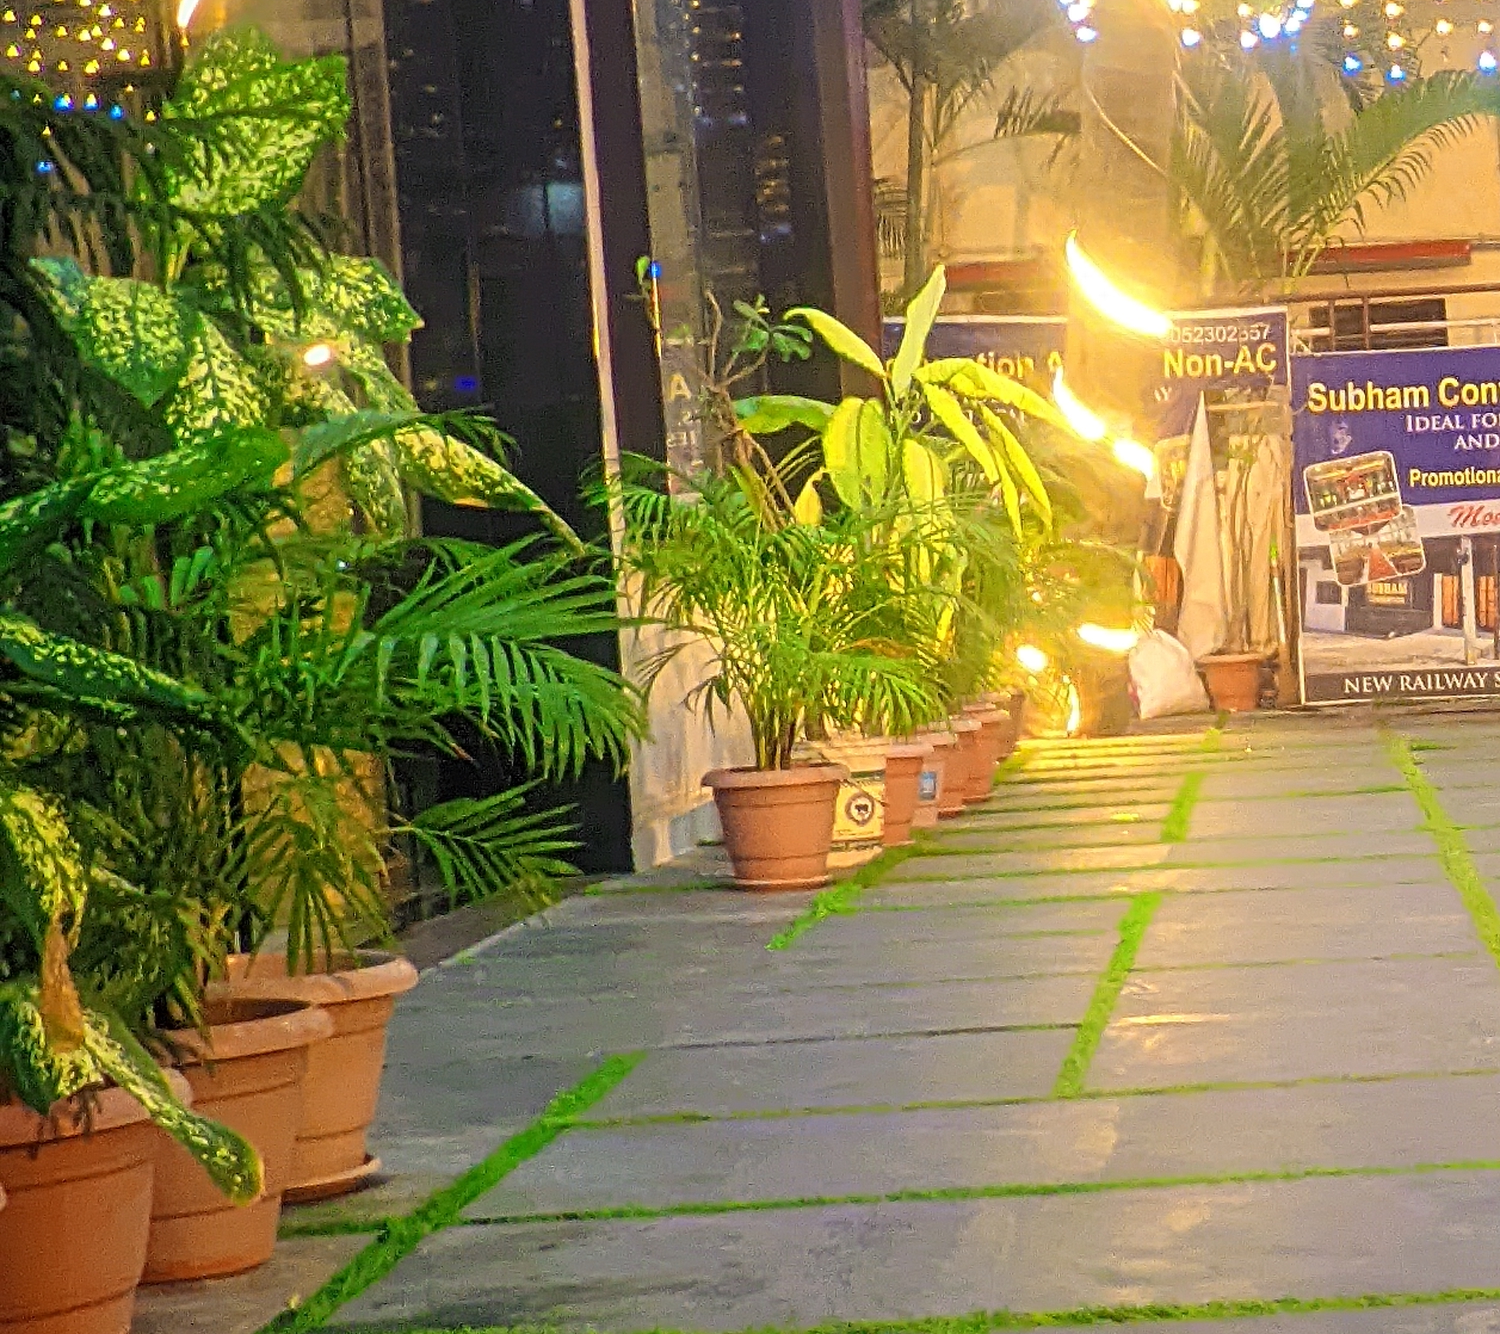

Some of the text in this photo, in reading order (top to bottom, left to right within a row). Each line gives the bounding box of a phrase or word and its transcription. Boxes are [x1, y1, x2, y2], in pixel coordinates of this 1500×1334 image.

[1163, 343, 1278, 378] Non-AC
[1307, 379, 1430, 413] Subham
[1406, 415, 1465, 432] IDEAL
[1453, 433, 1500, 450] AND
[1344, 674, 1393, 694] NEW
[1399, 670, 1489, 691] RAILWAY
